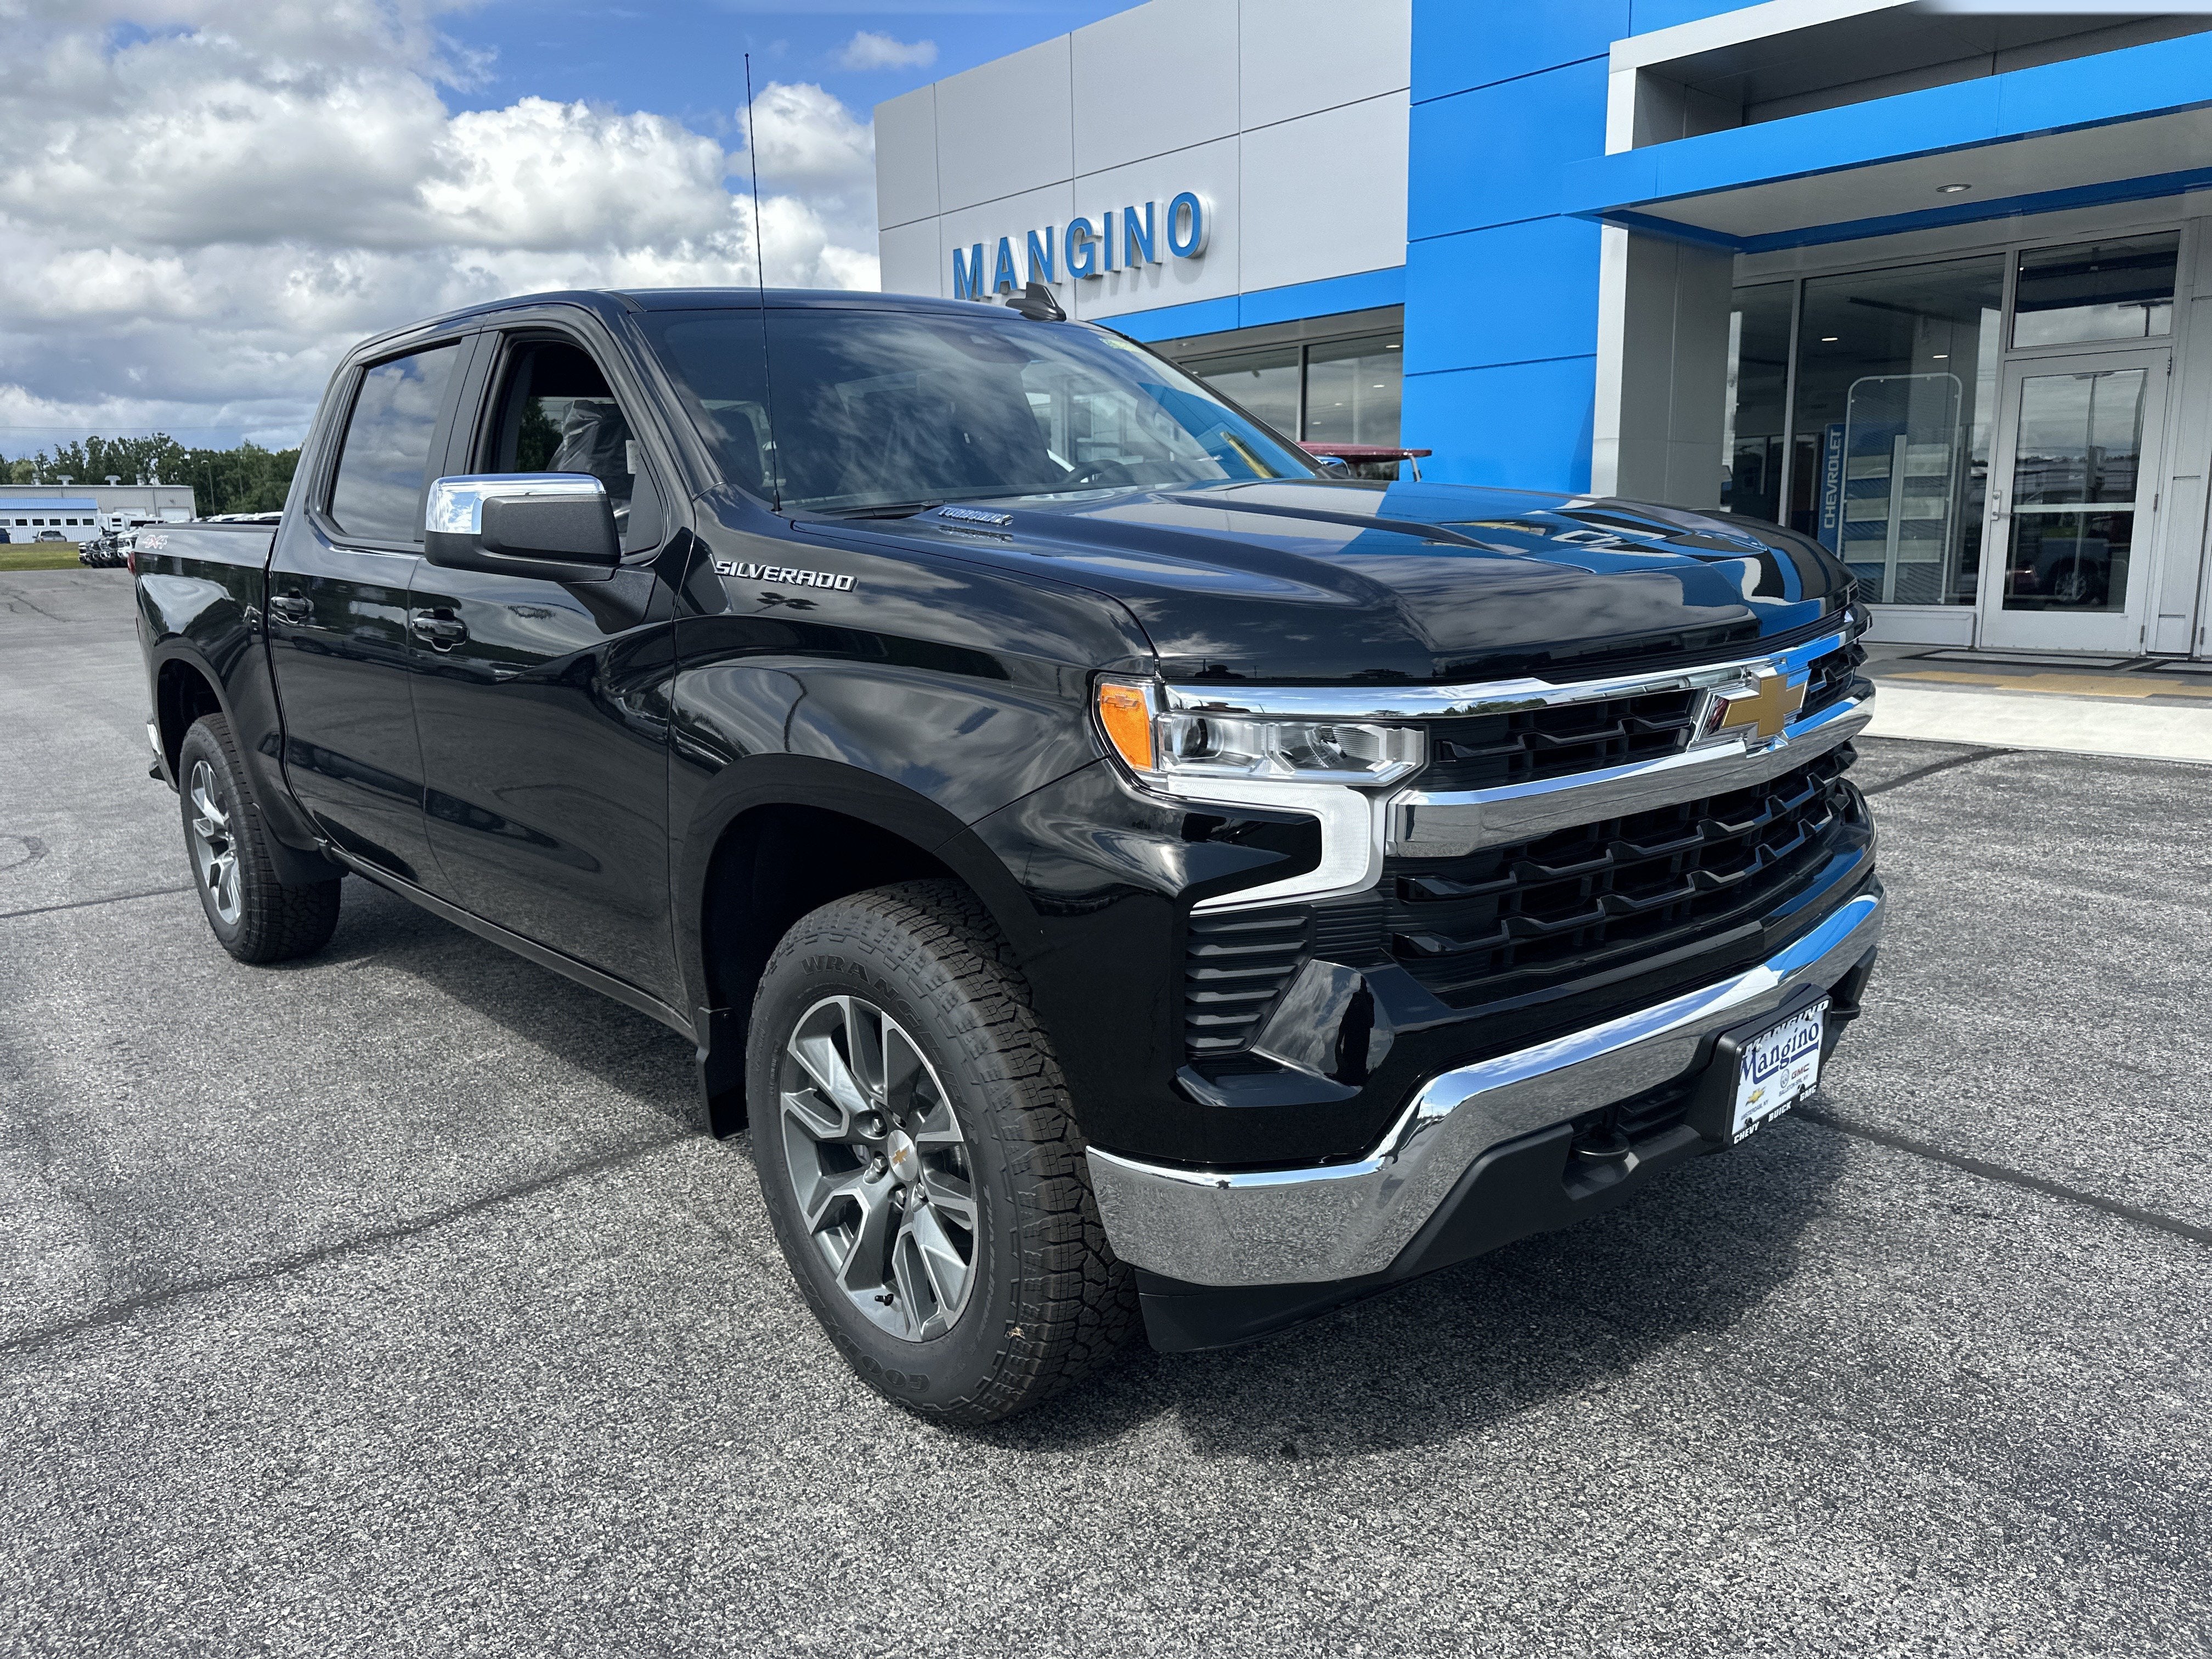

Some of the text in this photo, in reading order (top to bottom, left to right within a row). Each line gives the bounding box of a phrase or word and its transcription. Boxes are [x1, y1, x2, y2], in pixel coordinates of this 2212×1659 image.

[953, 192, 1209, 301] MANGINO
[1824, 428, 1842, 529] CHEVROLET
[714, 561, 857, 592] SILVERADO
[800, 955, 979, 1145] WRANGLER
[1742, 1023, 1820, 1084] Mangino
[1791, 1063, 1810, 1080] GMC
[1734, 1085, 1818, 1144] CHEVY BUICK GMC
